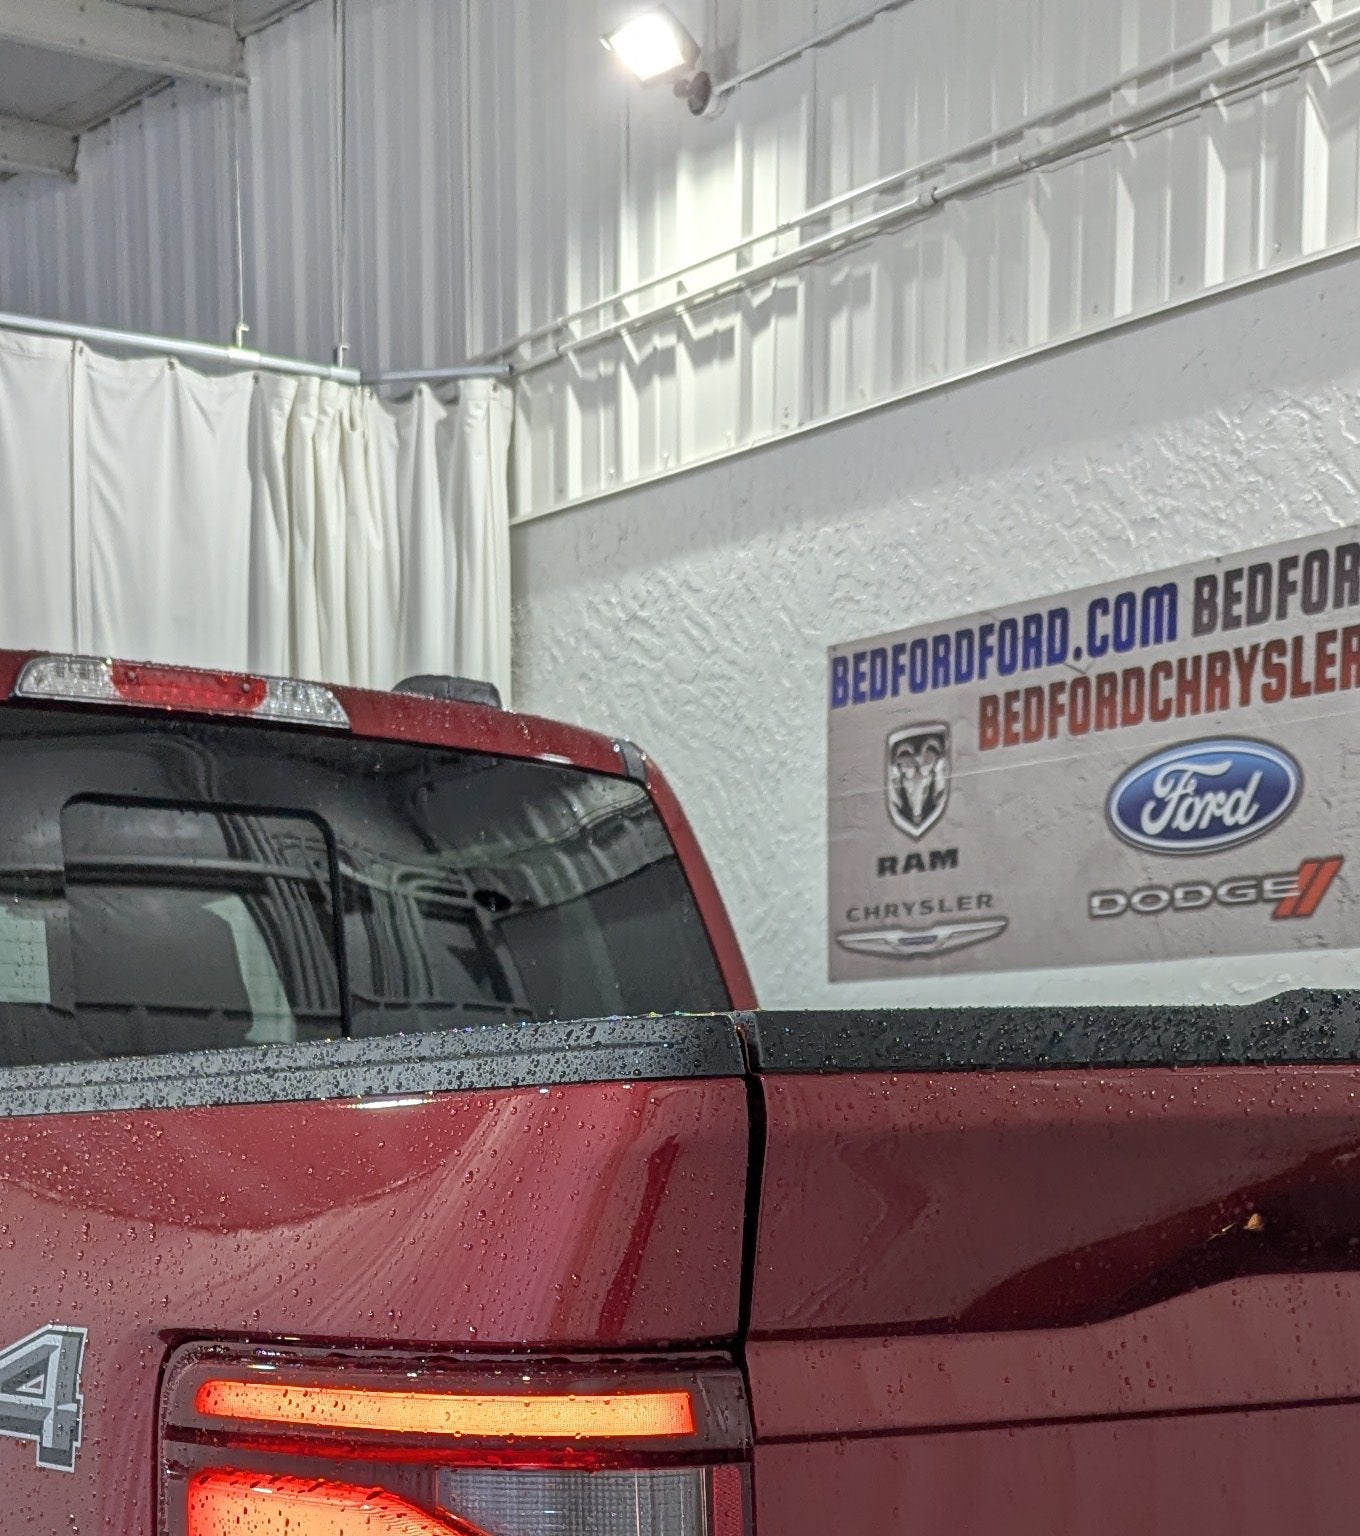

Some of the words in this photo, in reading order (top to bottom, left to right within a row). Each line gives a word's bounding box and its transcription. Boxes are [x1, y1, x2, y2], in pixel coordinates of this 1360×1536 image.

[831, 582, 1178, 709] BEDFORDFORD.COM
[1140, 759, 1264, 836] Ford
[876, 847, 960, 878] RAM
[845, 894, 994, 923] CHRYSLER
[1089, 870, 1302, 920] DODGE
